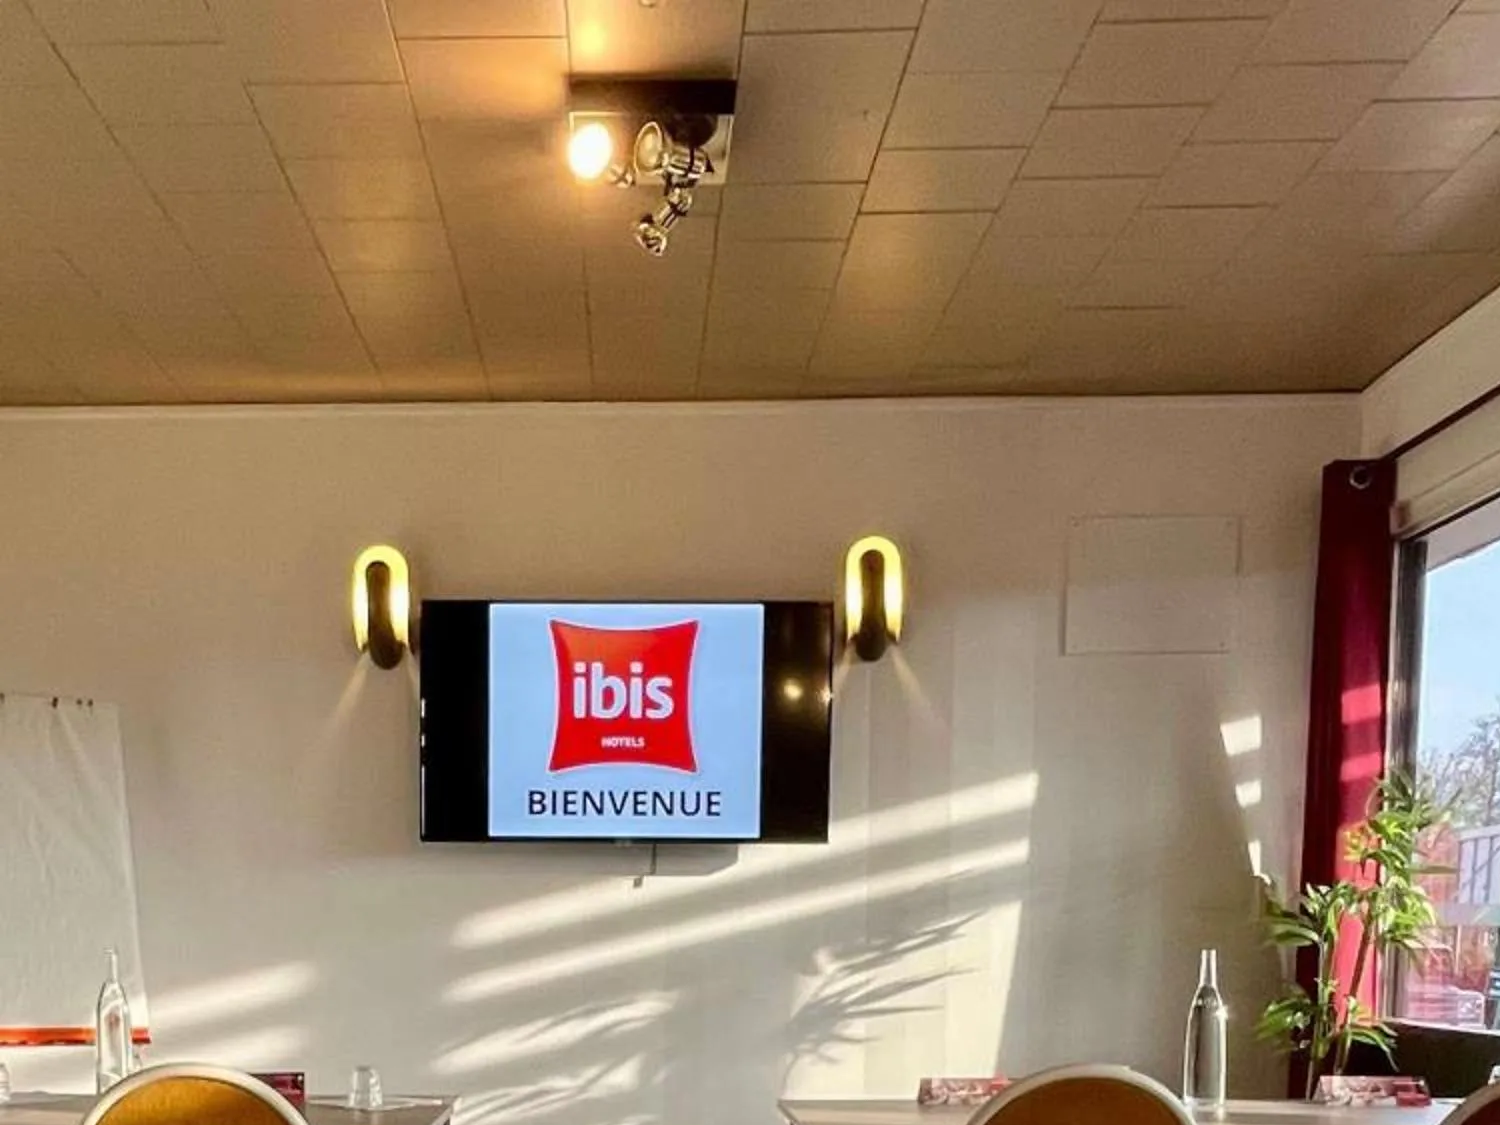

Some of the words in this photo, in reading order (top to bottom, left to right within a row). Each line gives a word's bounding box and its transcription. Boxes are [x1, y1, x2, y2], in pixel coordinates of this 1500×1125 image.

[573, 662, 675, 720] ibis
[601, 736, 646, 748] HOTELS
[528, 789, 722, 817] BIENVENUE
